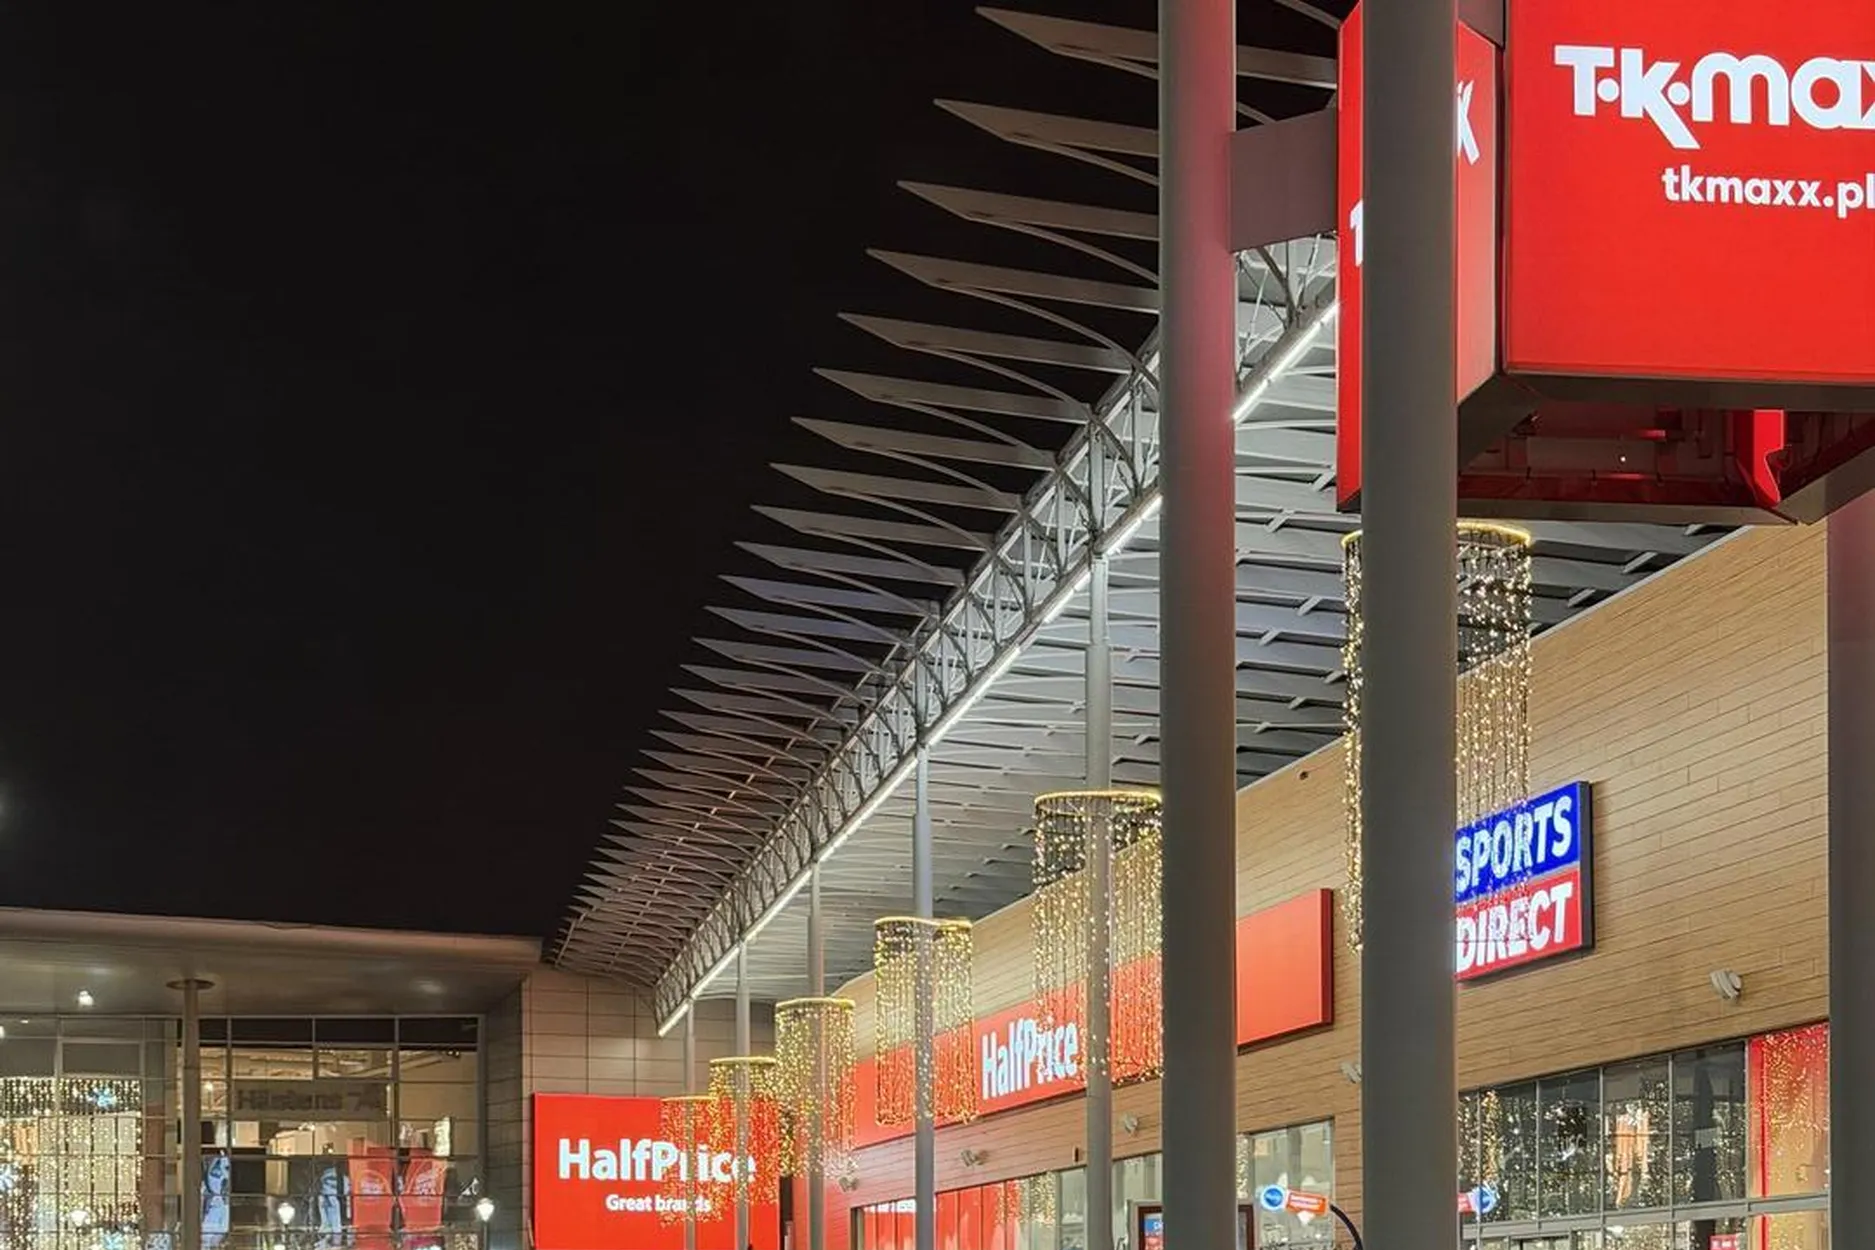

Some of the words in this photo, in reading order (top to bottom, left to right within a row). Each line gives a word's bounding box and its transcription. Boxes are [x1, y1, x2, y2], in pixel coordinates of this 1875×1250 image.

[1661, 164, 1875, 219] tkmaxx.pl
[1455, 795, 1572, 894] SPORTS
[1455, 881, 1574, 973] DIRECT
[982, 1017, 1078, 1100] HalfPrice
[605, 1193, 652, 1212] Great
